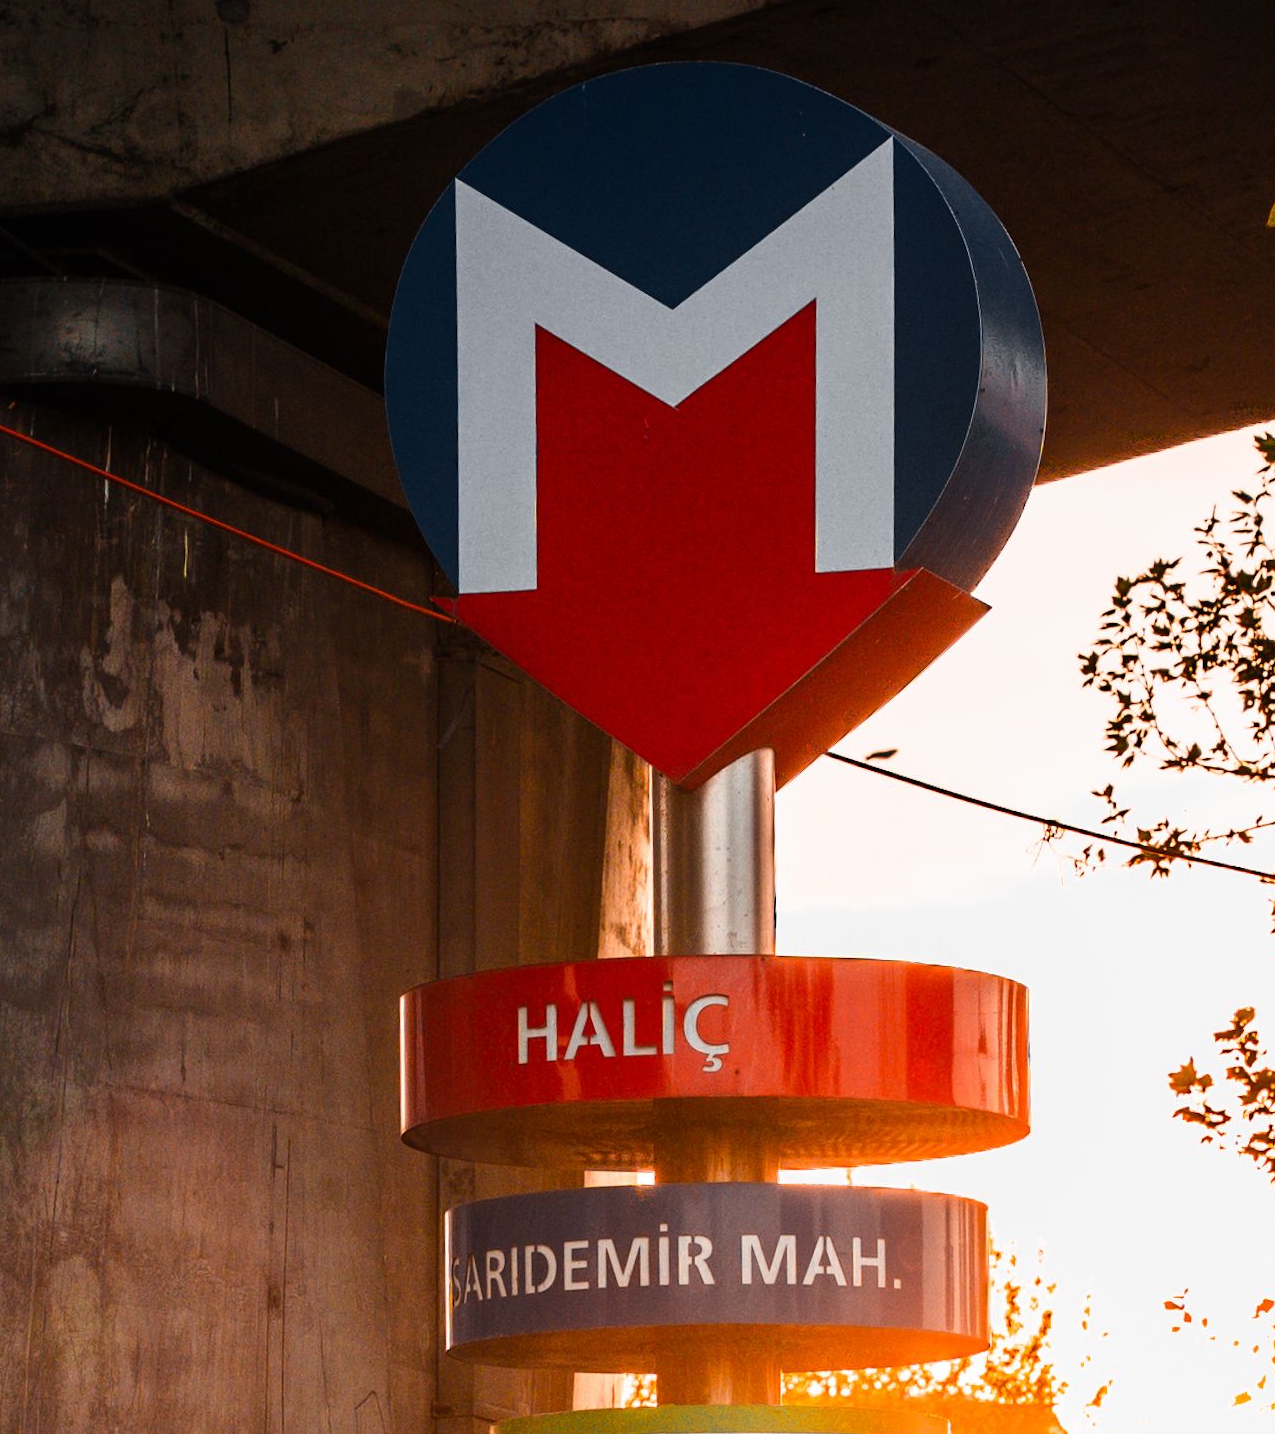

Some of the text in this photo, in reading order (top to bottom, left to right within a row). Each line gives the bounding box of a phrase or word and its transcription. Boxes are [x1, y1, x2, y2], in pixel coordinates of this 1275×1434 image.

[518, 980, 730, 1073] HALİÇ
[451, 1223, 901, 1308] SARIDEMİR MAH.
